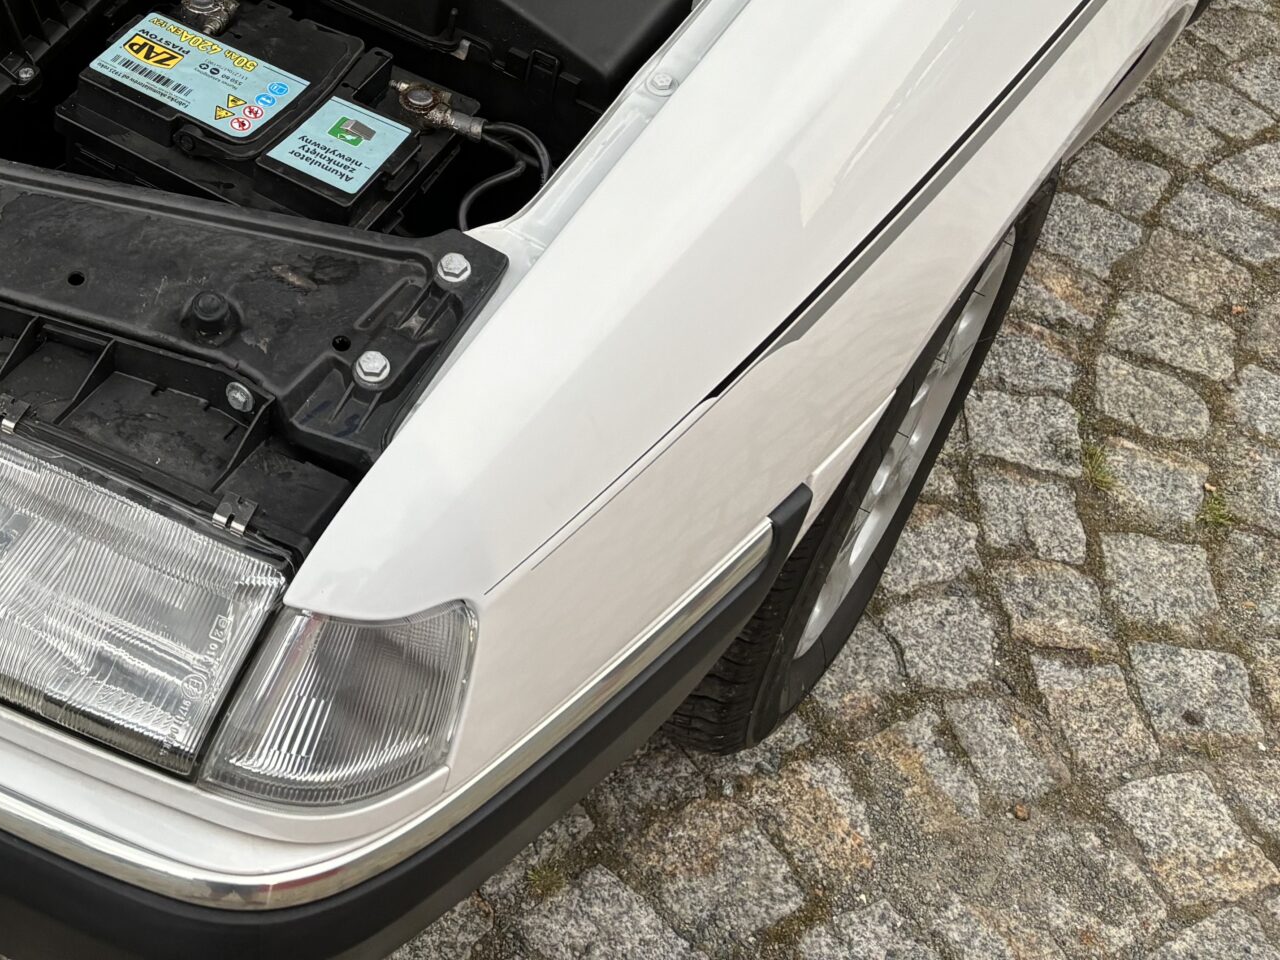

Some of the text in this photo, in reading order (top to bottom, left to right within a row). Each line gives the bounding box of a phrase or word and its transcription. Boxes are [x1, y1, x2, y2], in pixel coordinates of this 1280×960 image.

[128, 42, 179, 67] ZAP
[224, 49, 258, 72] 50Ah
[288, 149, 353, 181] Akumulator
[298, 135, 362, 167] niewylewny
[298, 144, 356, 172] zamknięty
